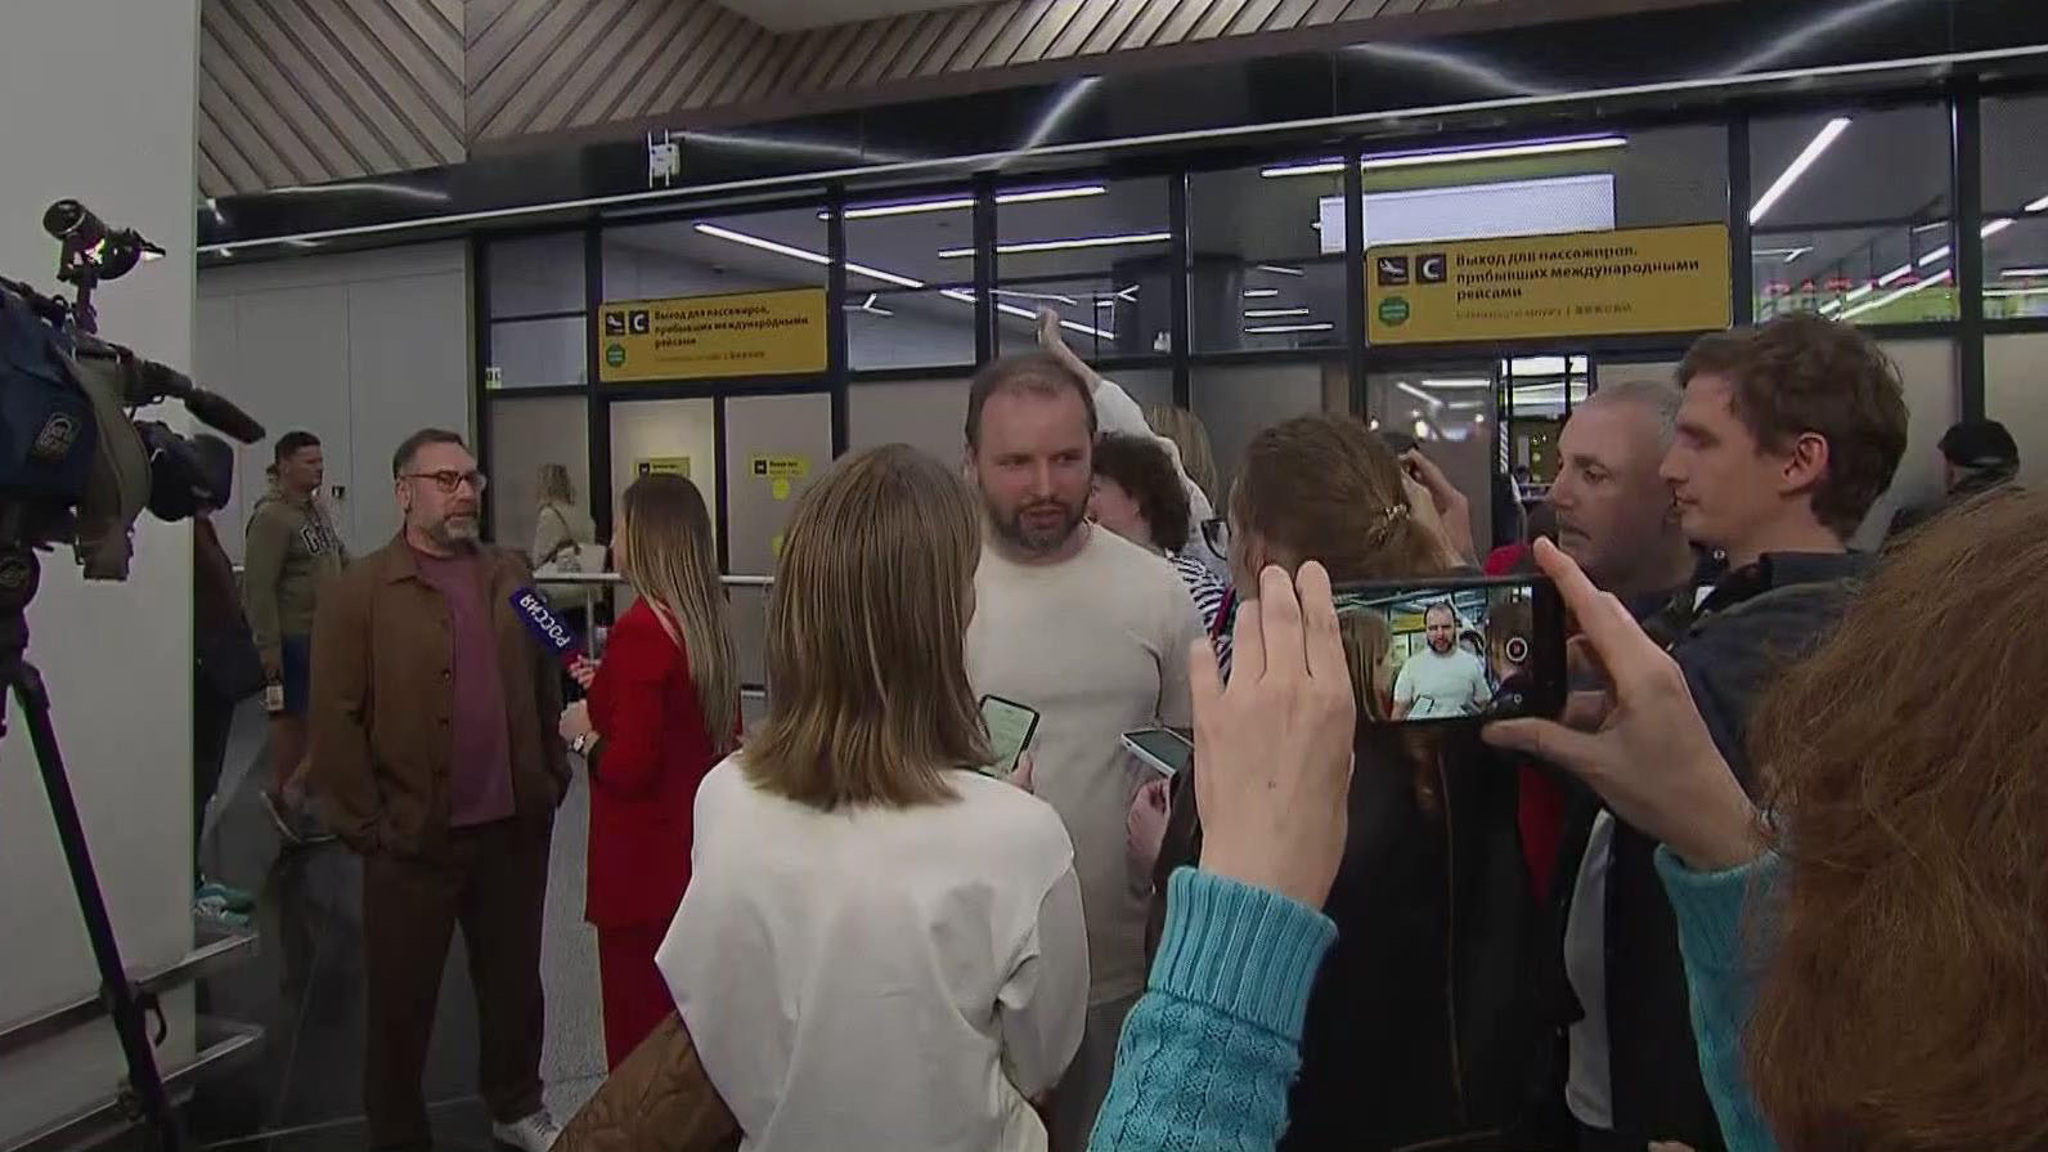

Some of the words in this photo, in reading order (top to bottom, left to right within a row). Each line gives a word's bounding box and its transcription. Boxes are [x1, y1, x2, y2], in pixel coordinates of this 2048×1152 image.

[1456, 253, 1506, 267] Выход
[1507, 252, 1536, 266] для
[1456, 269, 1548, 287] прибывших
[1550, 260, 1699, 280] международными
[1457, 287, 1523, 303] рейсами
[520, 594, 571, 647] РОССИЯ
